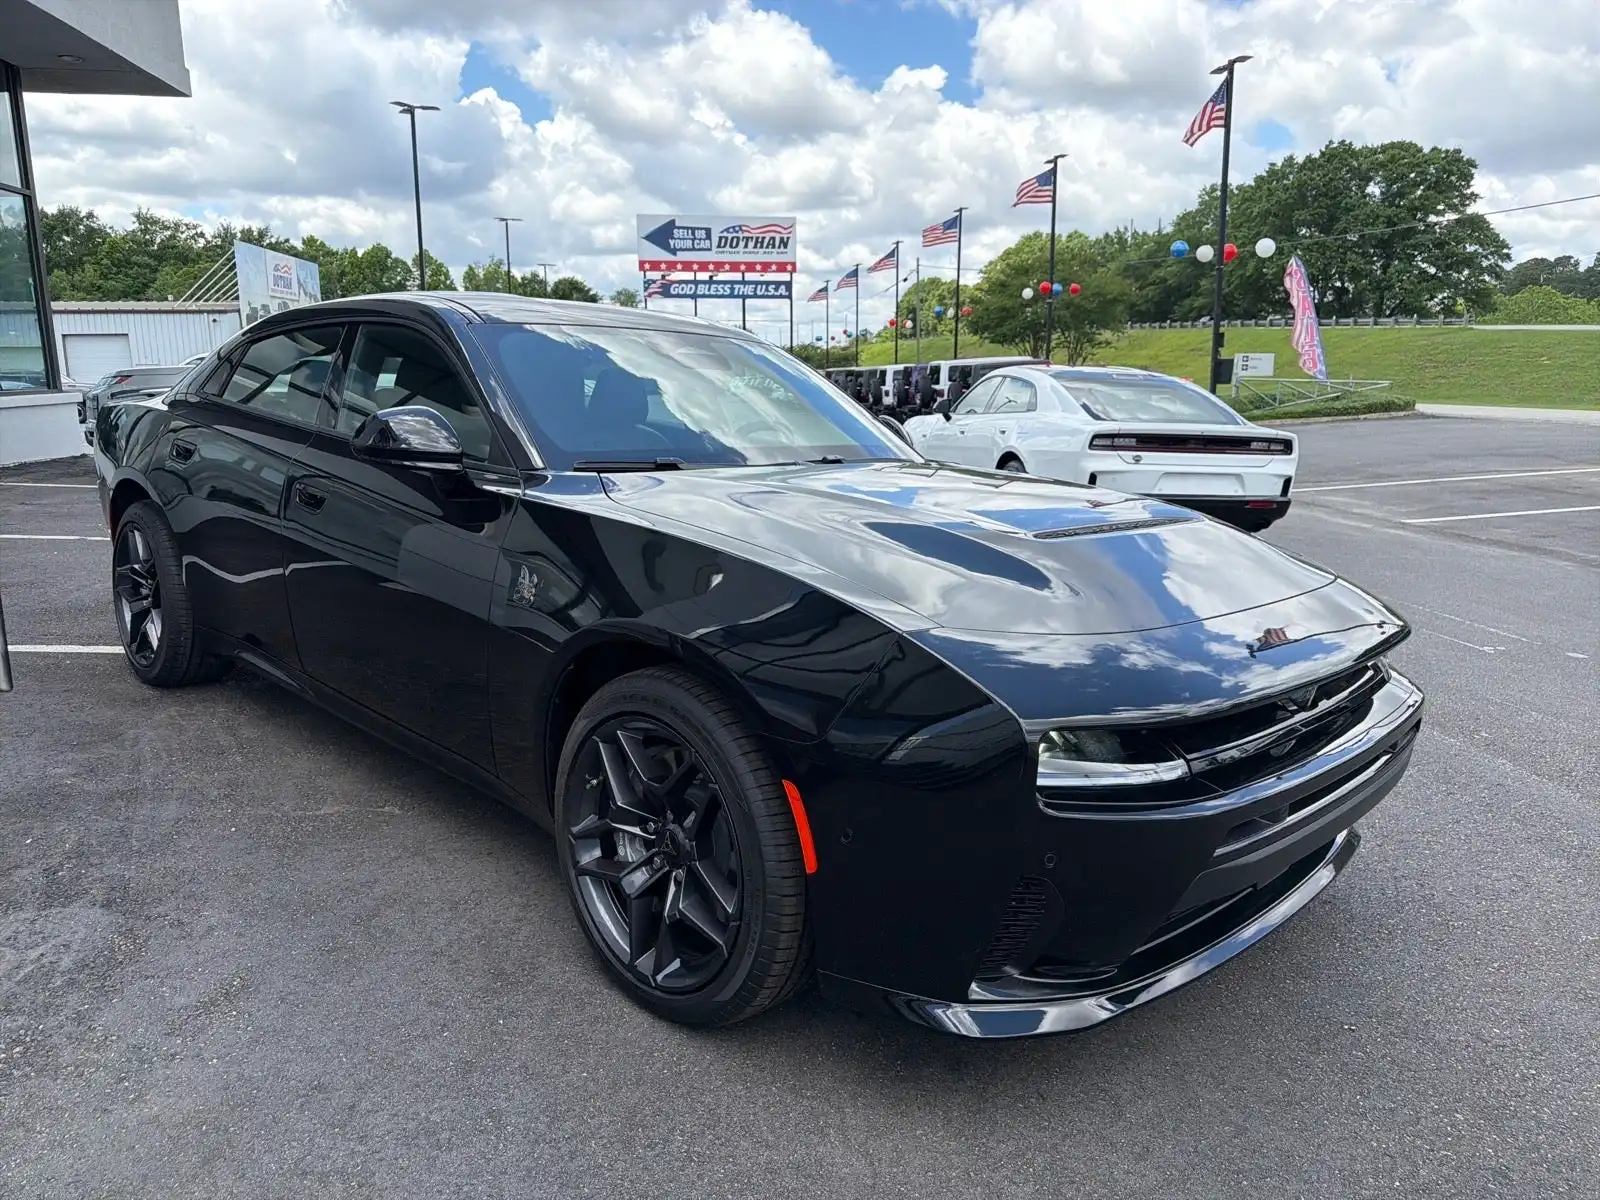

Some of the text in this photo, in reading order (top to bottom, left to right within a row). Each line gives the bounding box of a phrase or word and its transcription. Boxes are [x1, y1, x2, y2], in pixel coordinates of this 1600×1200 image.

[673, 228, 706, 240] SELL US
[668, 239, 711, 250] YOUR CAR
[716, 235, 790, 250] DOTHAN
[670, 284, 789, 296] GOD BLESS THE U.S.A.
